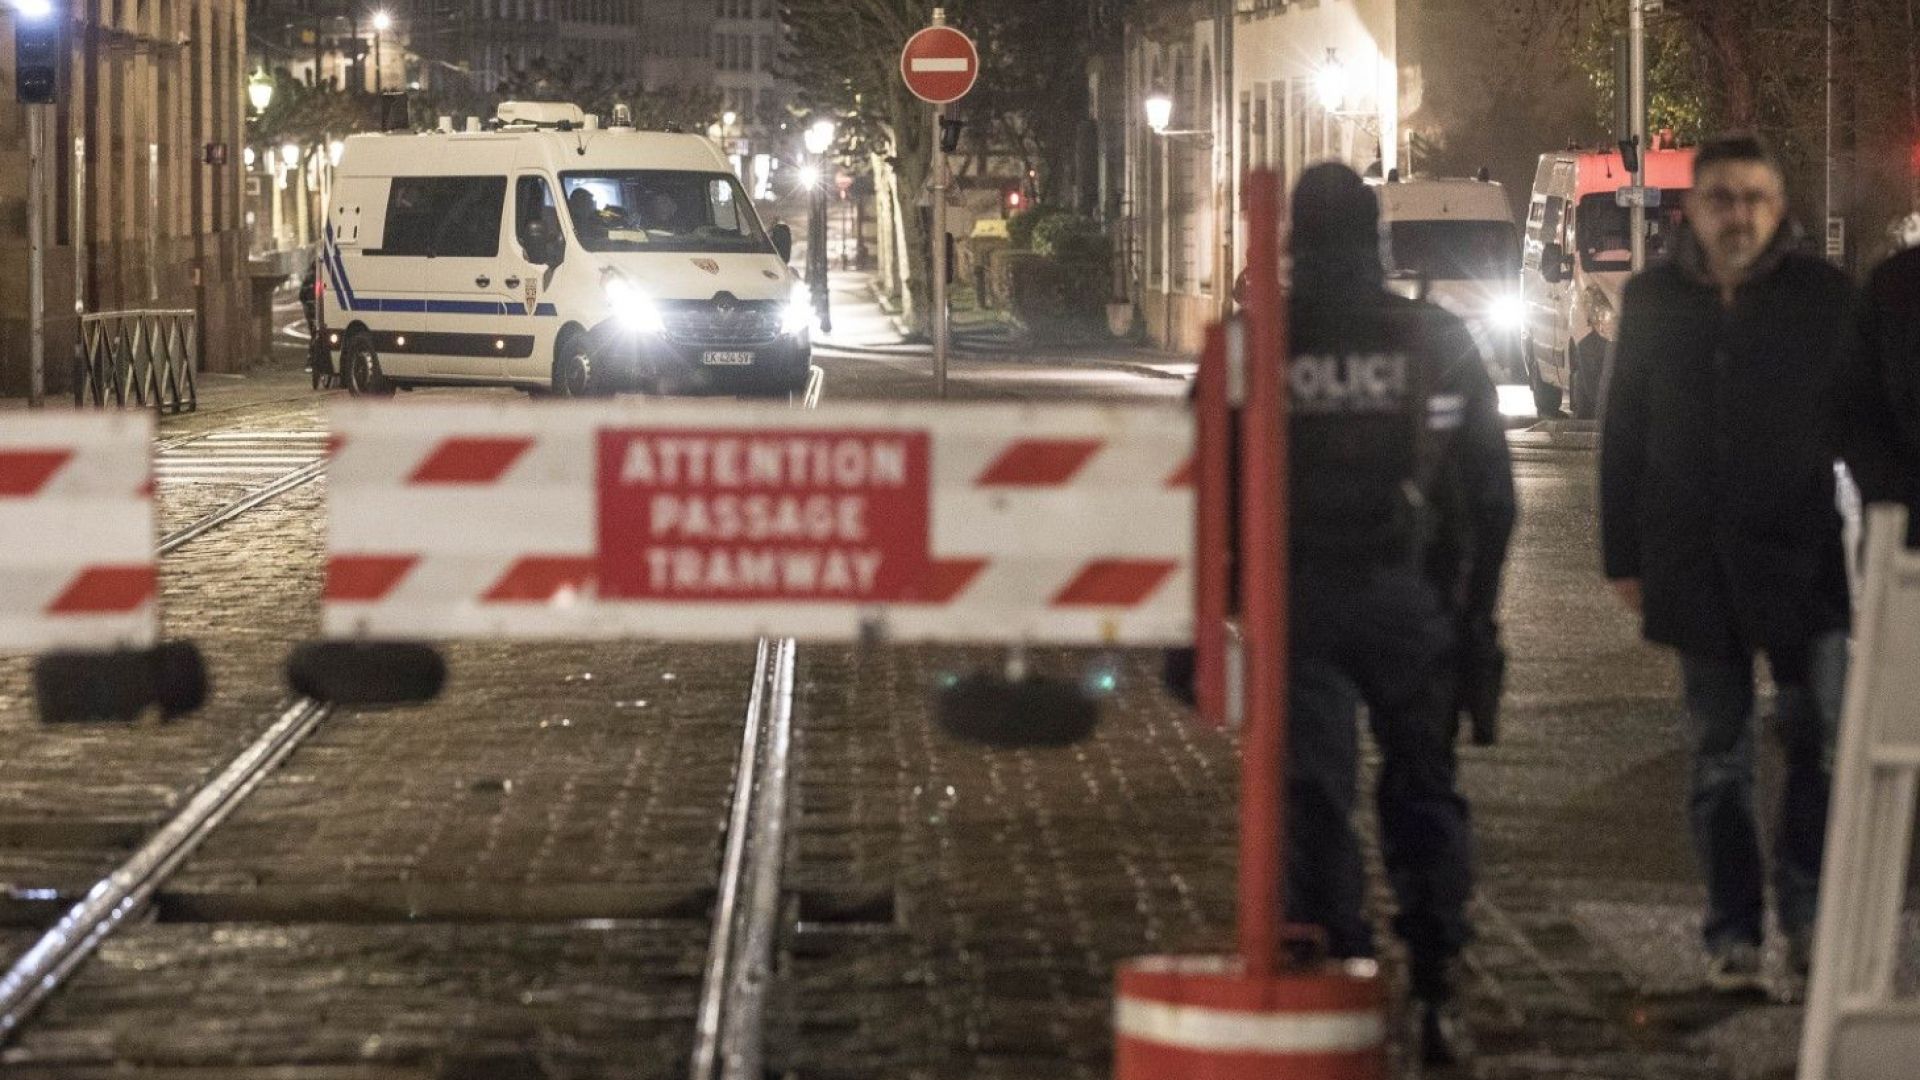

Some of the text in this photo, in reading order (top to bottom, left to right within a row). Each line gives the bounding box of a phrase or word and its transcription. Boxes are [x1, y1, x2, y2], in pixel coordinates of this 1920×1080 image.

[621, 438, 905, 485] ATTENTION
[651, 494, 868, 540] PASSAGE
[646, 548, 882, 592] TRAMWAY
